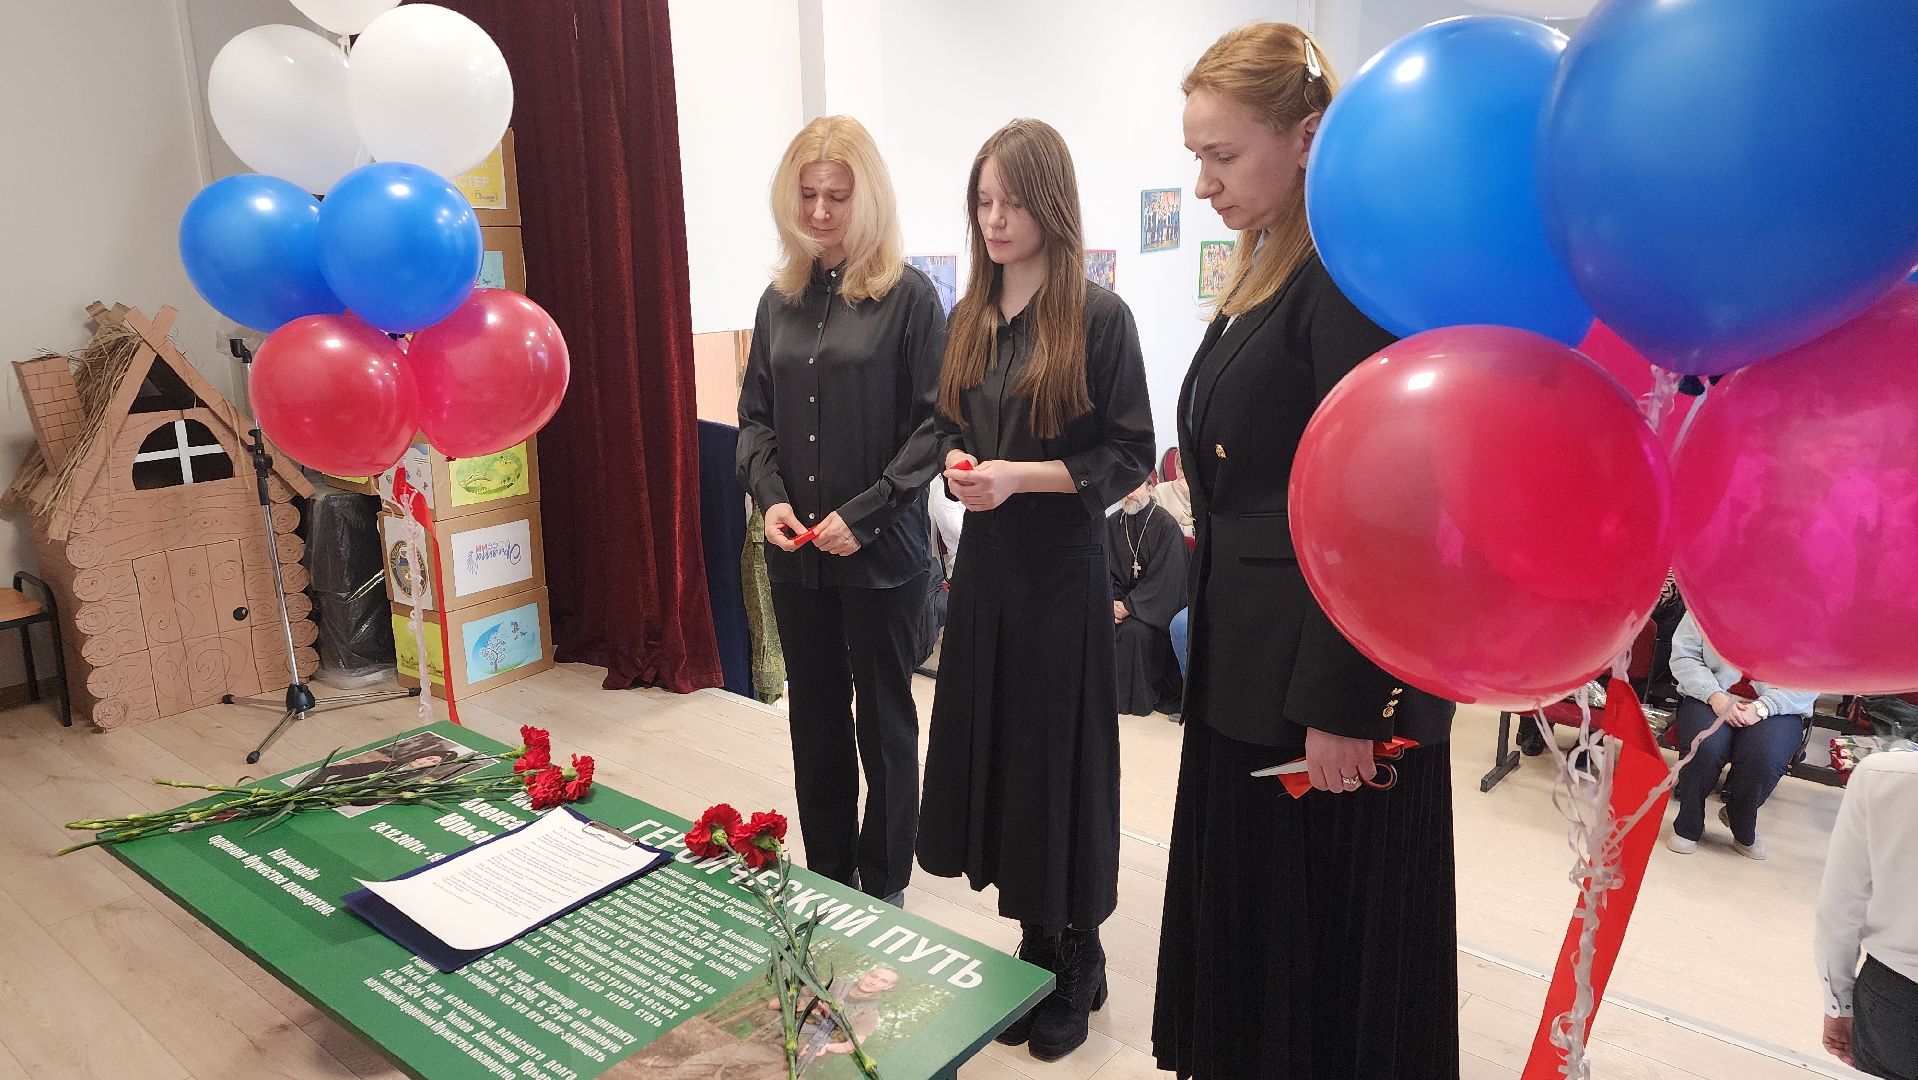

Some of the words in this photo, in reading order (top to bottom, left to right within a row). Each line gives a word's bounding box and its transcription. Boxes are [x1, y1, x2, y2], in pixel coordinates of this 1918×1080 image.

[449, 175, 489, 186] АСТЕР
[458, 797, 526, 831] Алекса
[208, 834, 249, 859] орденом
[241, 854, 288, 885] Мужества
[281, 881, 335, 917] посмертно.
[267, 847, 320, 881] Награждён
[656, 886, 692, 904] первый
[693, 880, 732, 901] Юрьевич
[725, 897, 763, 916] родился
[624, 893, 663, 914] переехал
[665, 913, 700, 935] Россию,
[699, 930, 718, 942] где
[715, 938, 765, 965] продолжил
[626, 883, 655, 898] пятый
[650, 894, 676, 909] класс
[721, 928, 769, 954] Александр
[650, 918, 679, 935] школе
[694, 893, 725, 909] городе
[542, 927, 573, 947] классе.
[570, 942, 615, 968] Принимал
[609, 964, 651, 988] активное
[644, 984, 684, 1007] участие
[568, 927, 612, 953] Александр
[608, 949, 657, 977] продолжил
[653, 973, 696, 998] обучение
[573, 917, 615, 940] аттестат
[629, 947, 679, 975] основном
[679, 973, 717, 995] общем
[597, 906, 618, 916] рос
[704, 959, 738, 980] сыном,
[621, 930, 665, 953] любящим
[869, 926, 982, 988] ПУТЬ
[362, 977, 405, 1005] награждён
[399, 1001, 436, 1027] орденом
[430, 1021, 474, 1052] Мужества
[392, 963, 431, 985] Погиб
[417, 982, 446, 996] при
[443, 994, 496, 1029] исполнении
[495, 1027, 546, 1061] воинского
[464, 960, 495, 974] СВО
[543, 1003, 573, 1023] 25-ую
[569, 1020, 628, 1054] штурмовую
[485, 956, 517, 972] 2024
[510, 969, 535, 985] года
[527, 980, 579, 1010] Александр
[591, 1015, 637, 1045] контракту
[538, 940, 595, 973] различных
[594, 970, 678, 1019] патриотических
[544, 955, 571, 974] Саша
[569, 971, 605, 993] всегда
[603, 990, 635, 1010] хотел
[634, 1008, 663, 1028] стать
[471, 1030, 529, 1064] Александр
[499, 992, 516, 1005] что
[511, 1001, 531, 1014] это
[525, 1010, 550, 1023] его
[538, 1017, 614, 1063] долг-защищать
